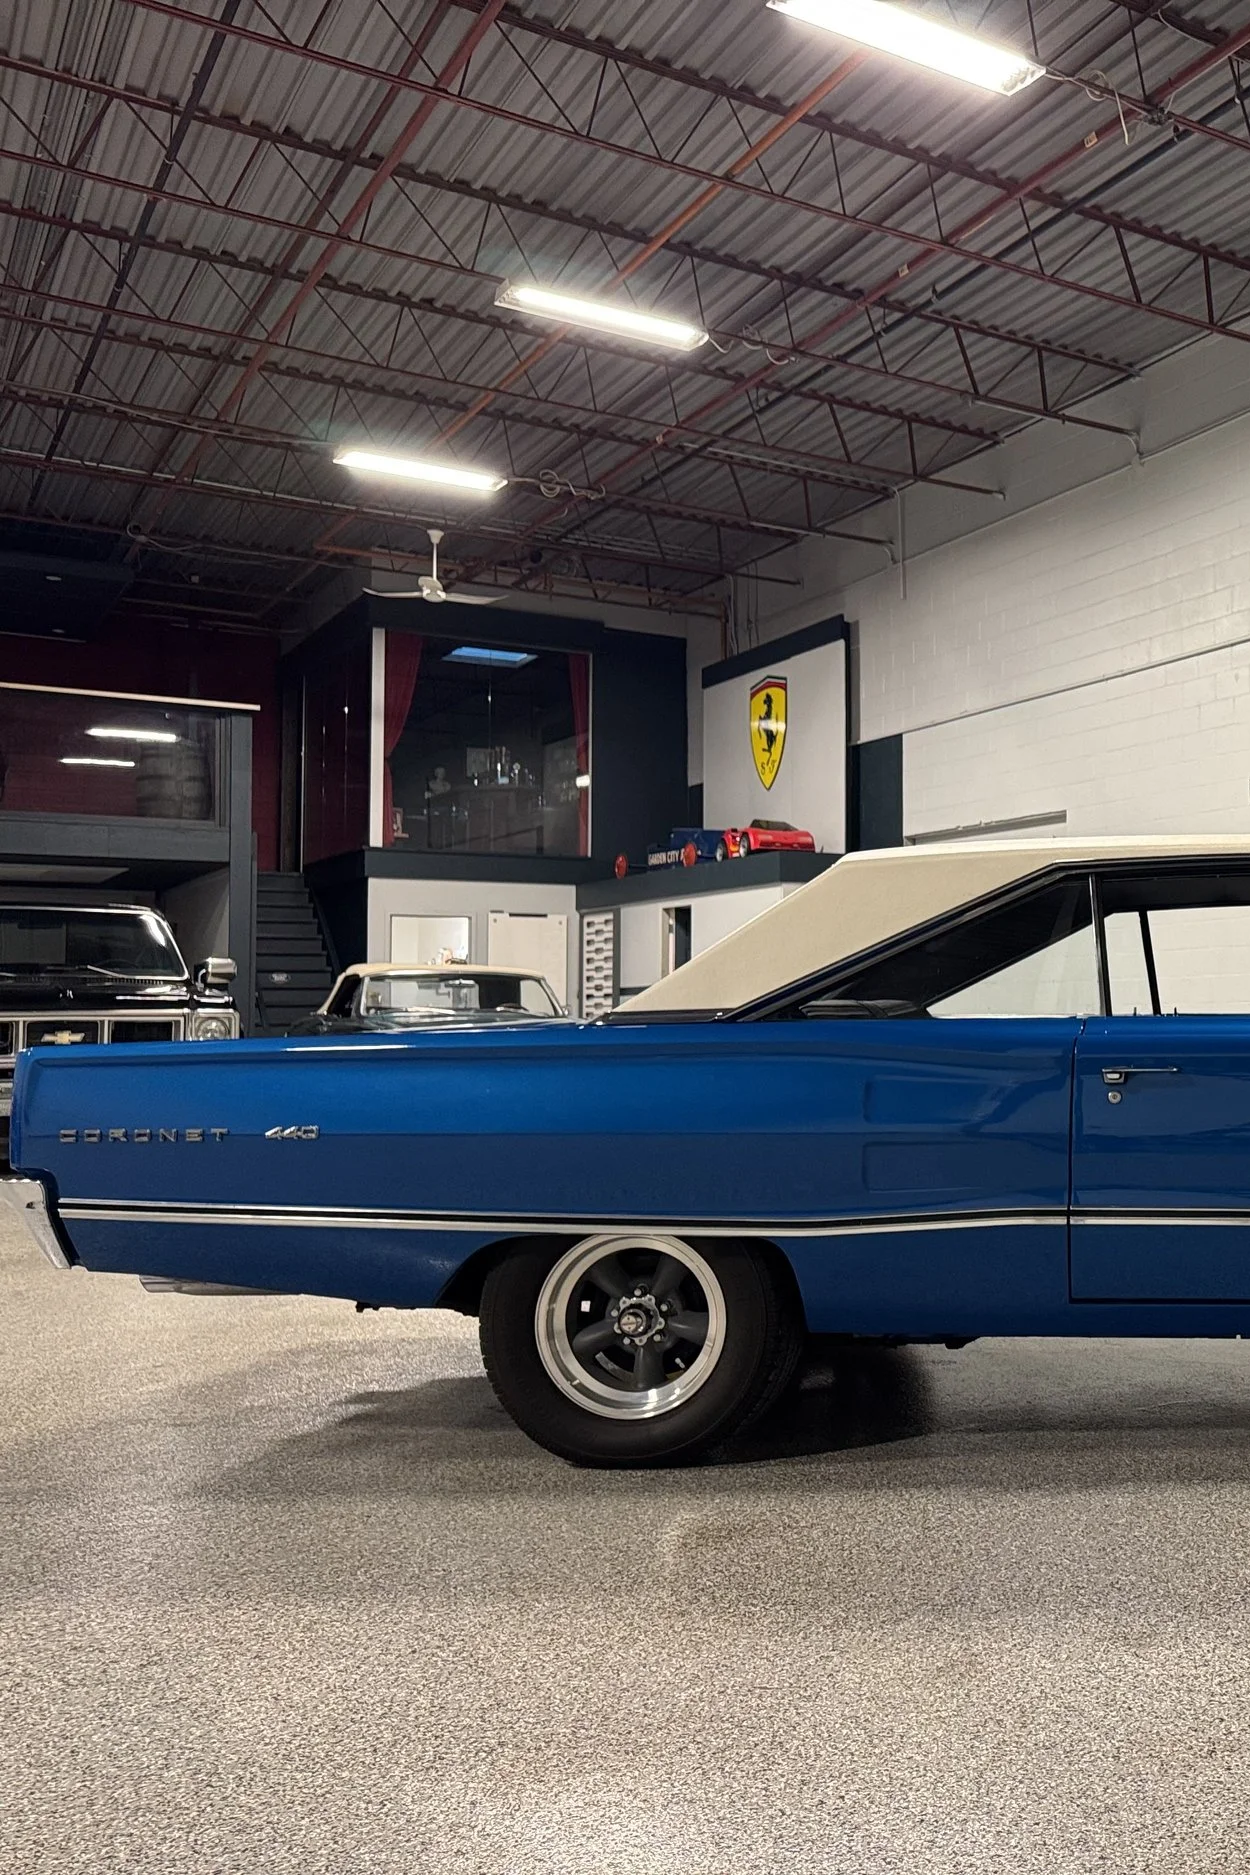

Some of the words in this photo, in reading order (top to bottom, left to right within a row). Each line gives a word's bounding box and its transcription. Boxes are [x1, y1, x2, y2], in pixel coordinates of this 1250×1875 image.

[667, 850, 680, 863] CITY
[59, 1127, 229, 1143] CORONET
[264, 1125, 320, 1140] 440
